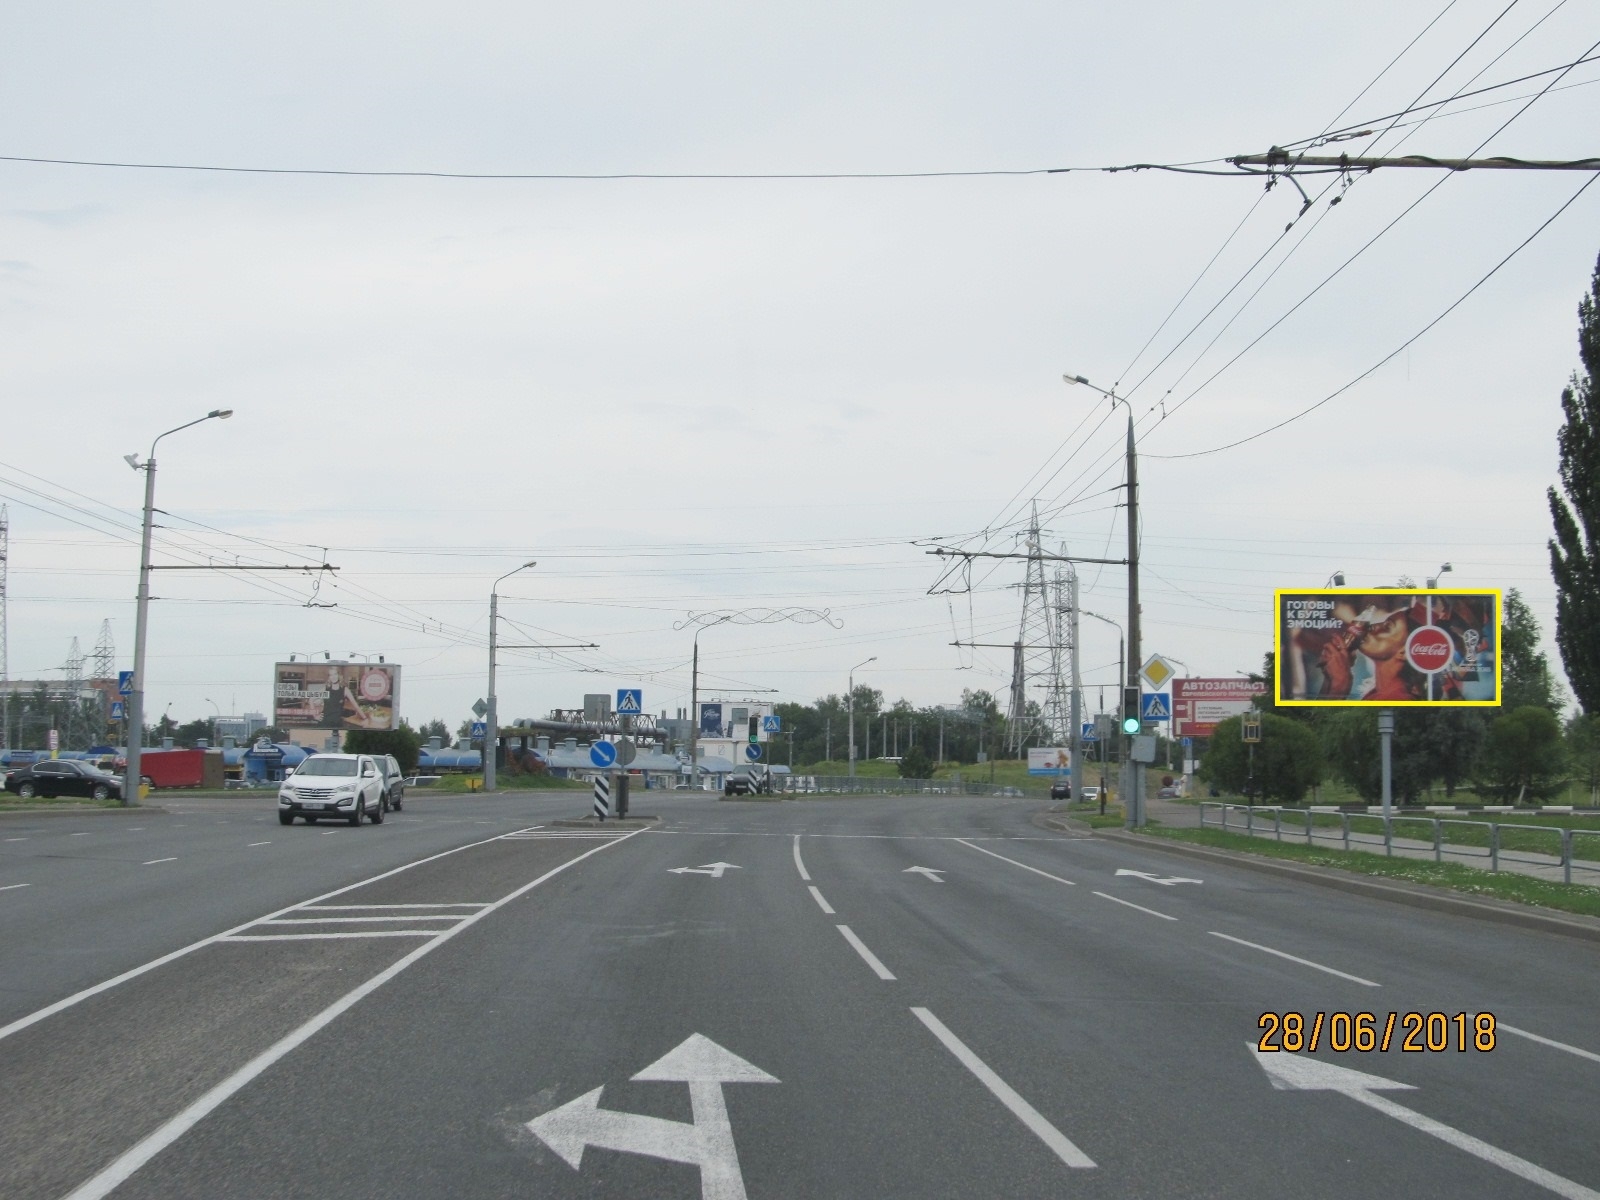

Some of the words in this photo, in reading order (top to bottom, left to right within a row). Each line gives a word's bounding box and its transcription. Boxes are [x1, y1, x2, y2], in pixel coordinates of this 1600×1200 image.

[1287, 601, 1335, 609] ГОТОВЫ
[1287, 610, 1296, 619] К
[1298, 610, 1327, 619] БУРЕ
[1287, 618, 1343, 630] ЭМОЦИЙ?
